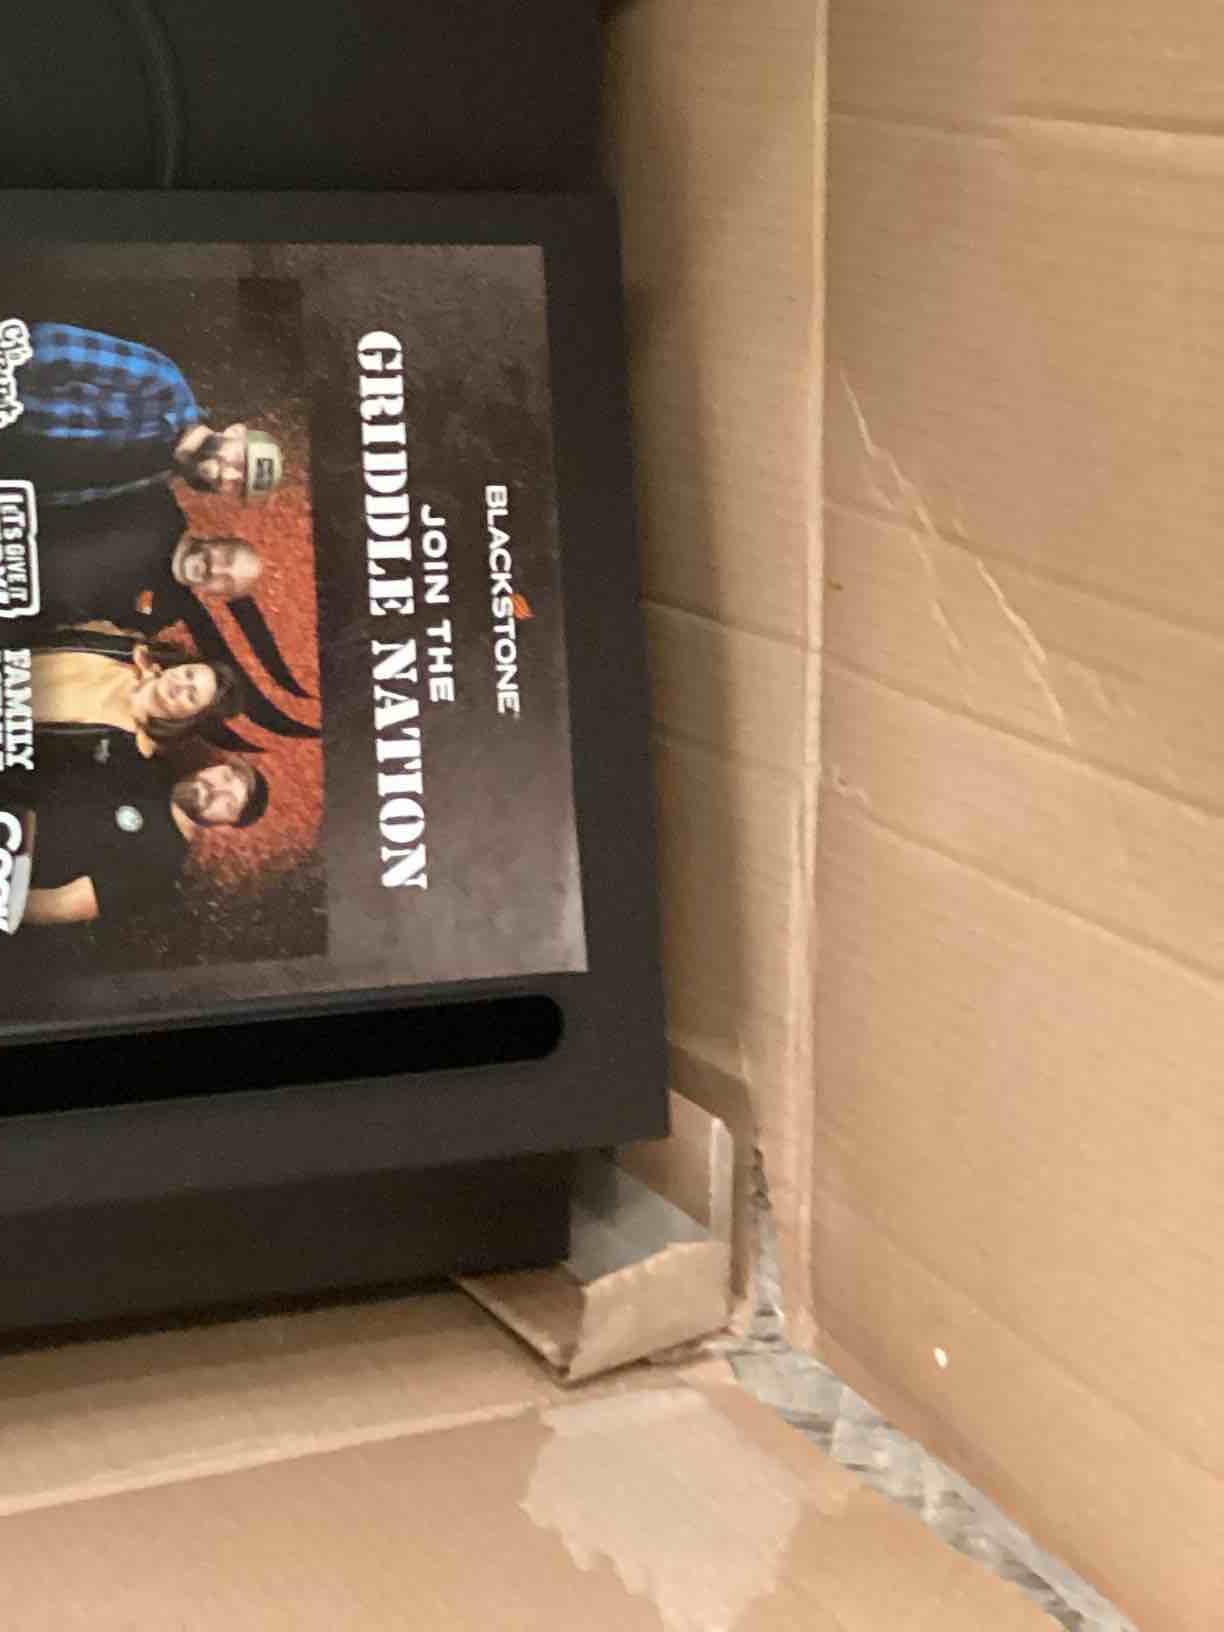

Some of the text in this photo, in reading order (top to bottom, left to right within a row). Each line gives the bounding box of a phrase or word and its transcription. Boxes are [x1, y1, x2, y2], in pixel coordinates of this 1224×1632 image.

[3, 543, 27, 583] GIVE
[356, 330, 428, 890] GRIDDLE NATION
[419, 504, 455, 702] JOIN THE
[484, 484, 520, 714] BLACKSTONE
[4, 649, 35, 770] FAMILY
